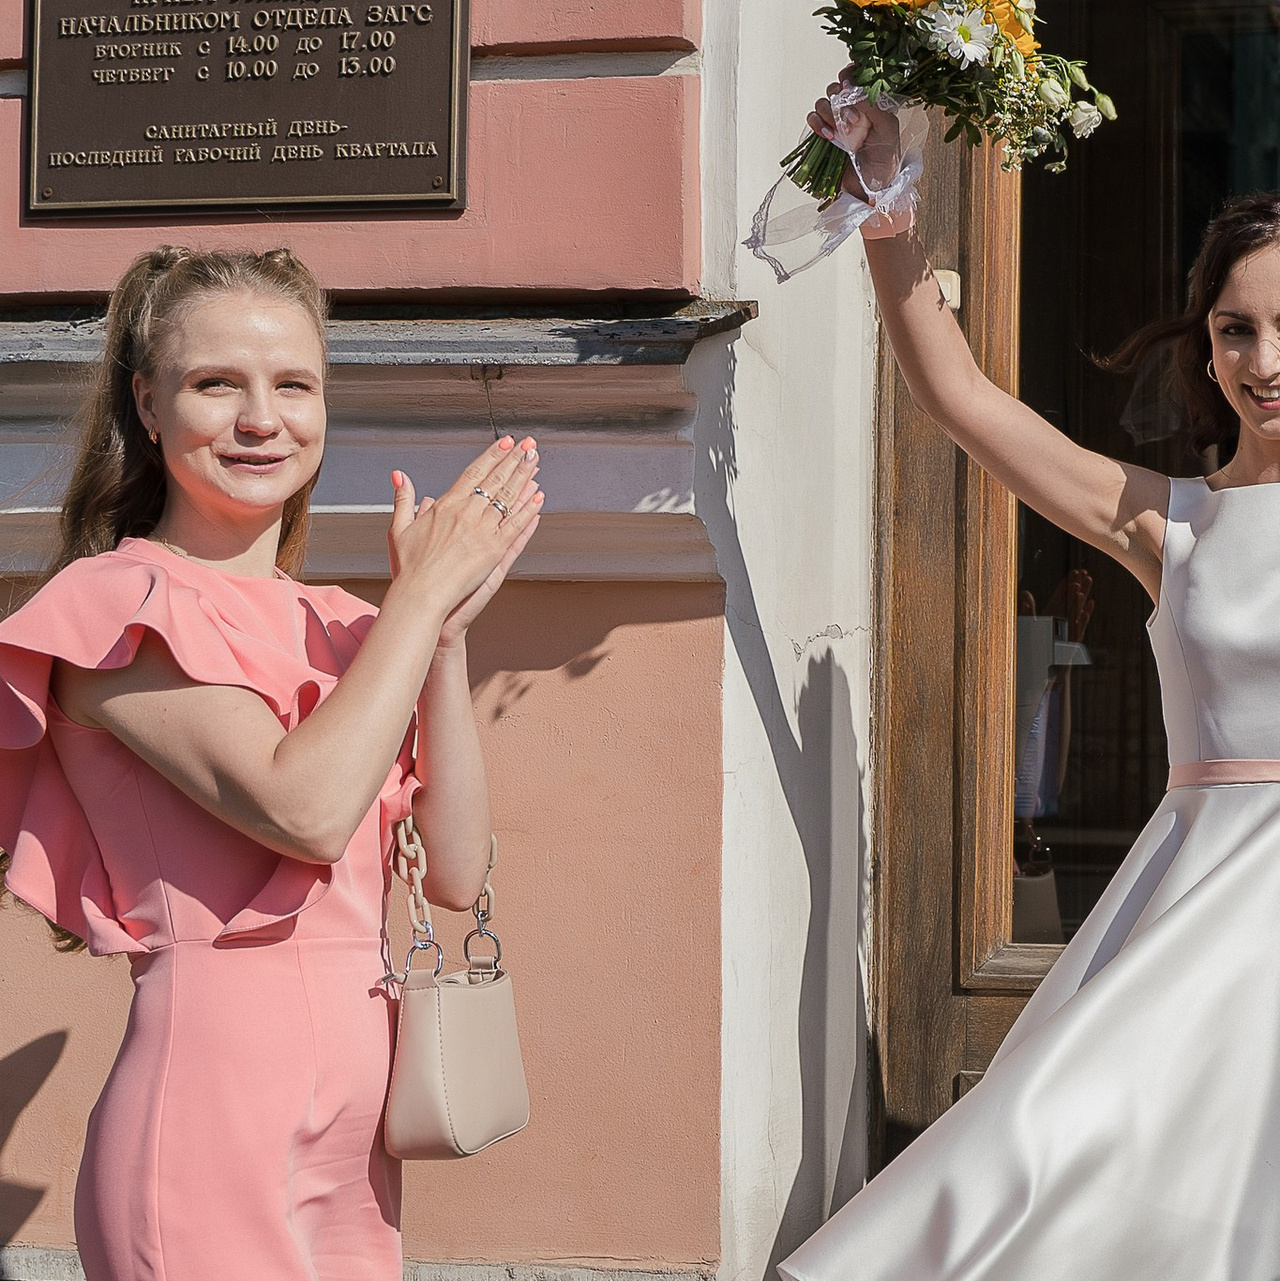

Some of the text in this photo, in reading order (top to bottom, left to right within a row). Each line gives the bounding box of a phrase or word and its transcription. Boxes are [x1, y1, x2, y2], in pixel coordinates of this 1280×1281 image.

[59, 5, 434, 37] НАЧАЛЬНИКОМ ОТДЕЛА ЗАГС
[226, 34, 280, 55] 14.00
[340, 30, 396, 51] 17.00
[226, 60, 279, 80] 10.00
[338, 56, 396, 76] 13.00
[145, 119, 278, 139] САНИТАРНЫЙ
[48, 141, 439, 168] ПОСЛЕДНИЙ РАБОЧИЙ ДЕНЬ КВАРТАЛА
